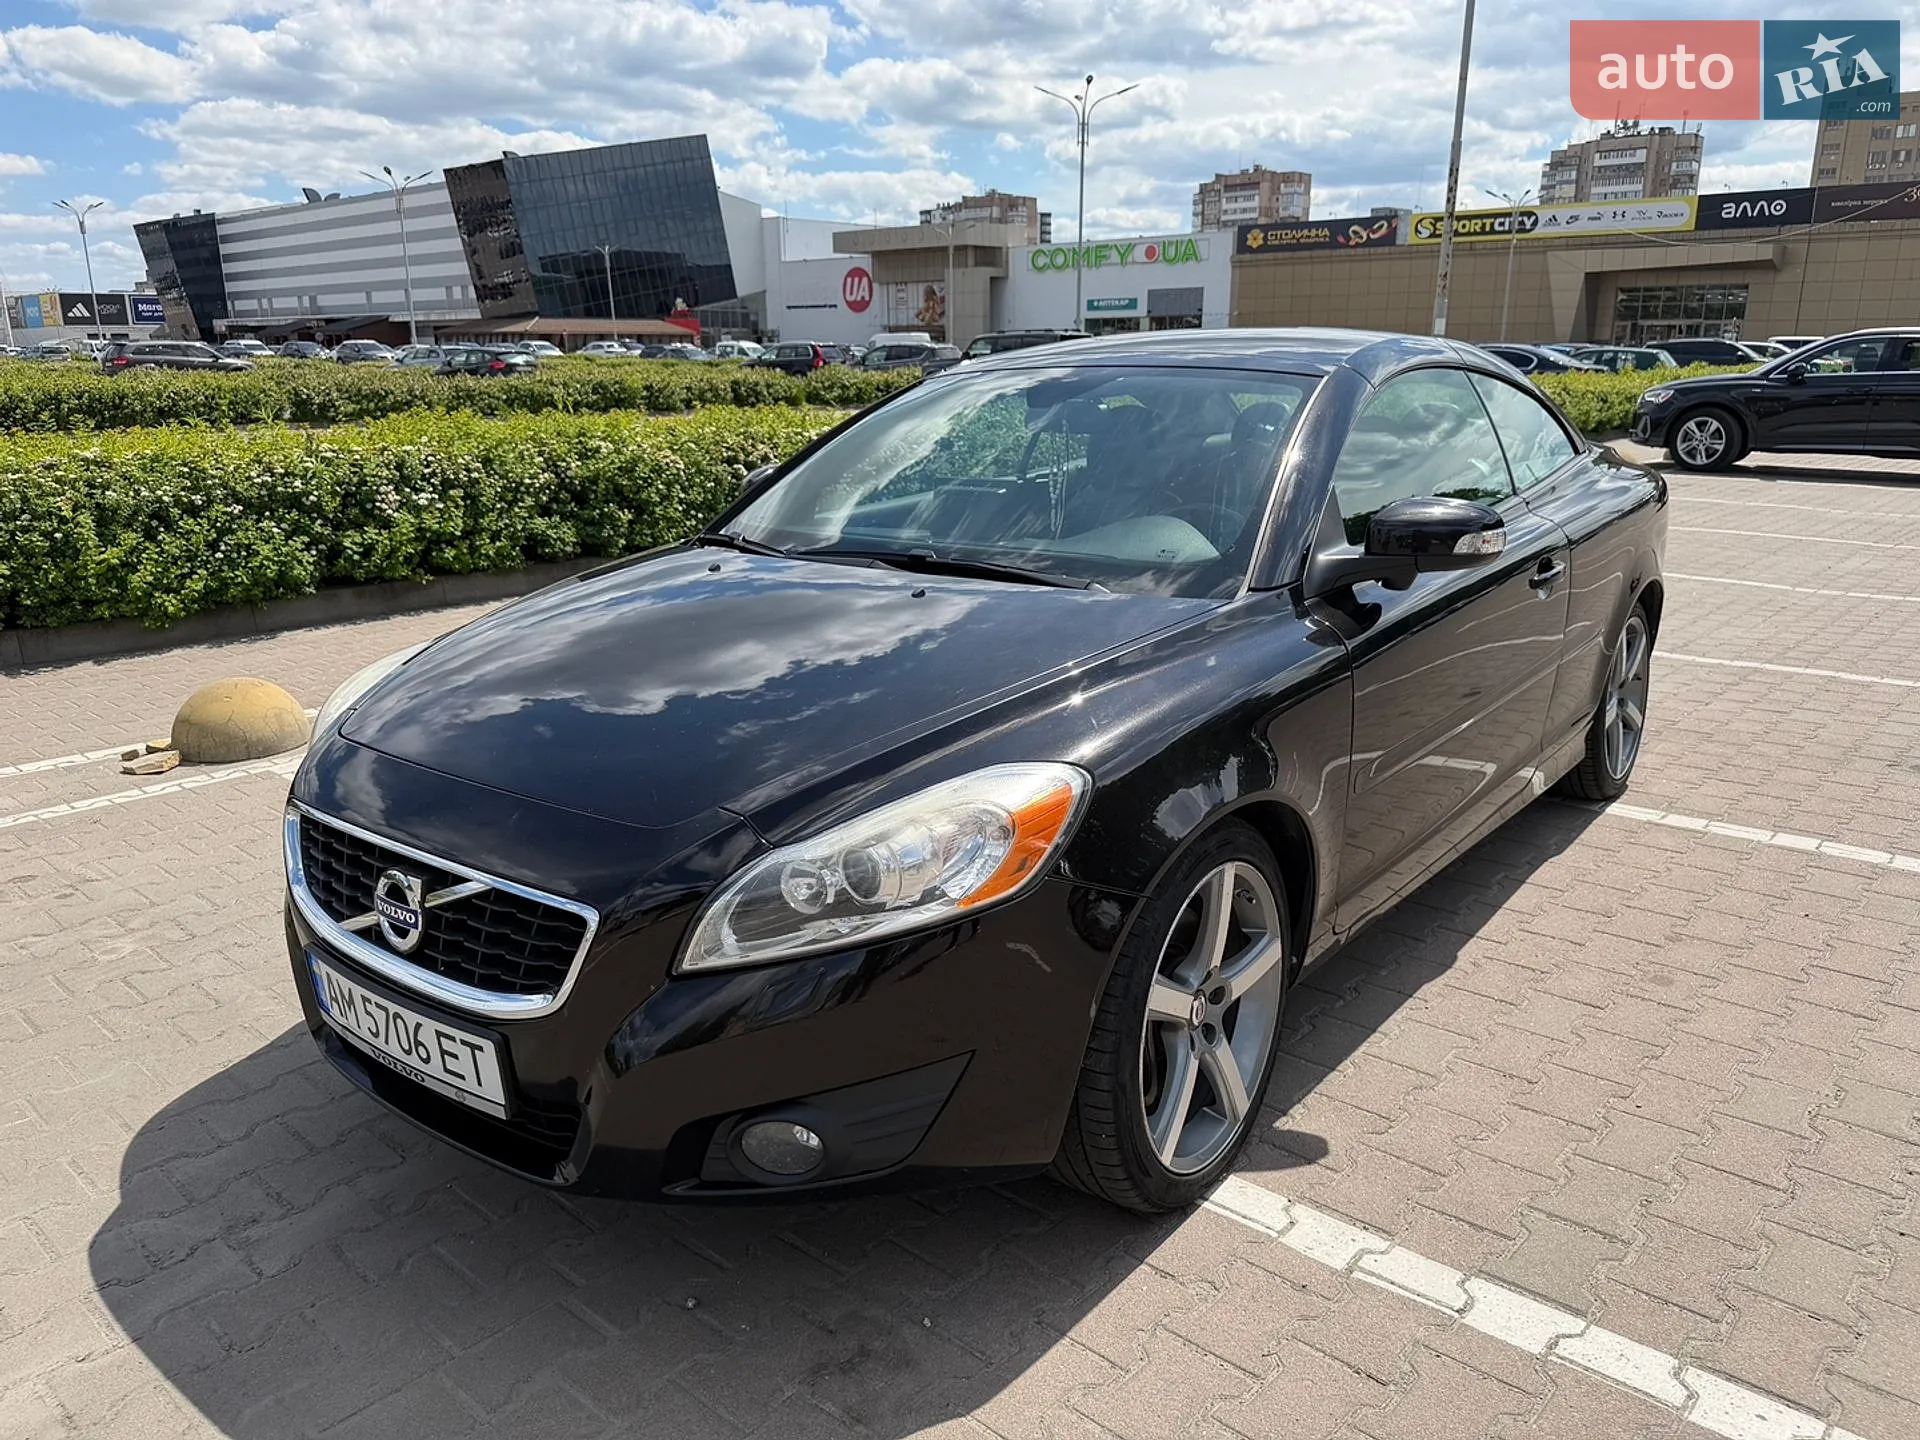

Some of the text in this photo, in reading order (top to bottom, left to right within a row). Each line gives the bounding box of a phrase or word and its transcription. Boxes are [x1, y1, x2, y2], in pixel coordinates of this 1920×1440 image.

[1031, 242, 1137, 273] COMFY
[844, 275, 871, 302] UA
[377, 900, 416, 924] VOLVO
[325, 971, 485, 1088] AM 5706 ET
[368, 1048, 426, 1084] VOLVO
